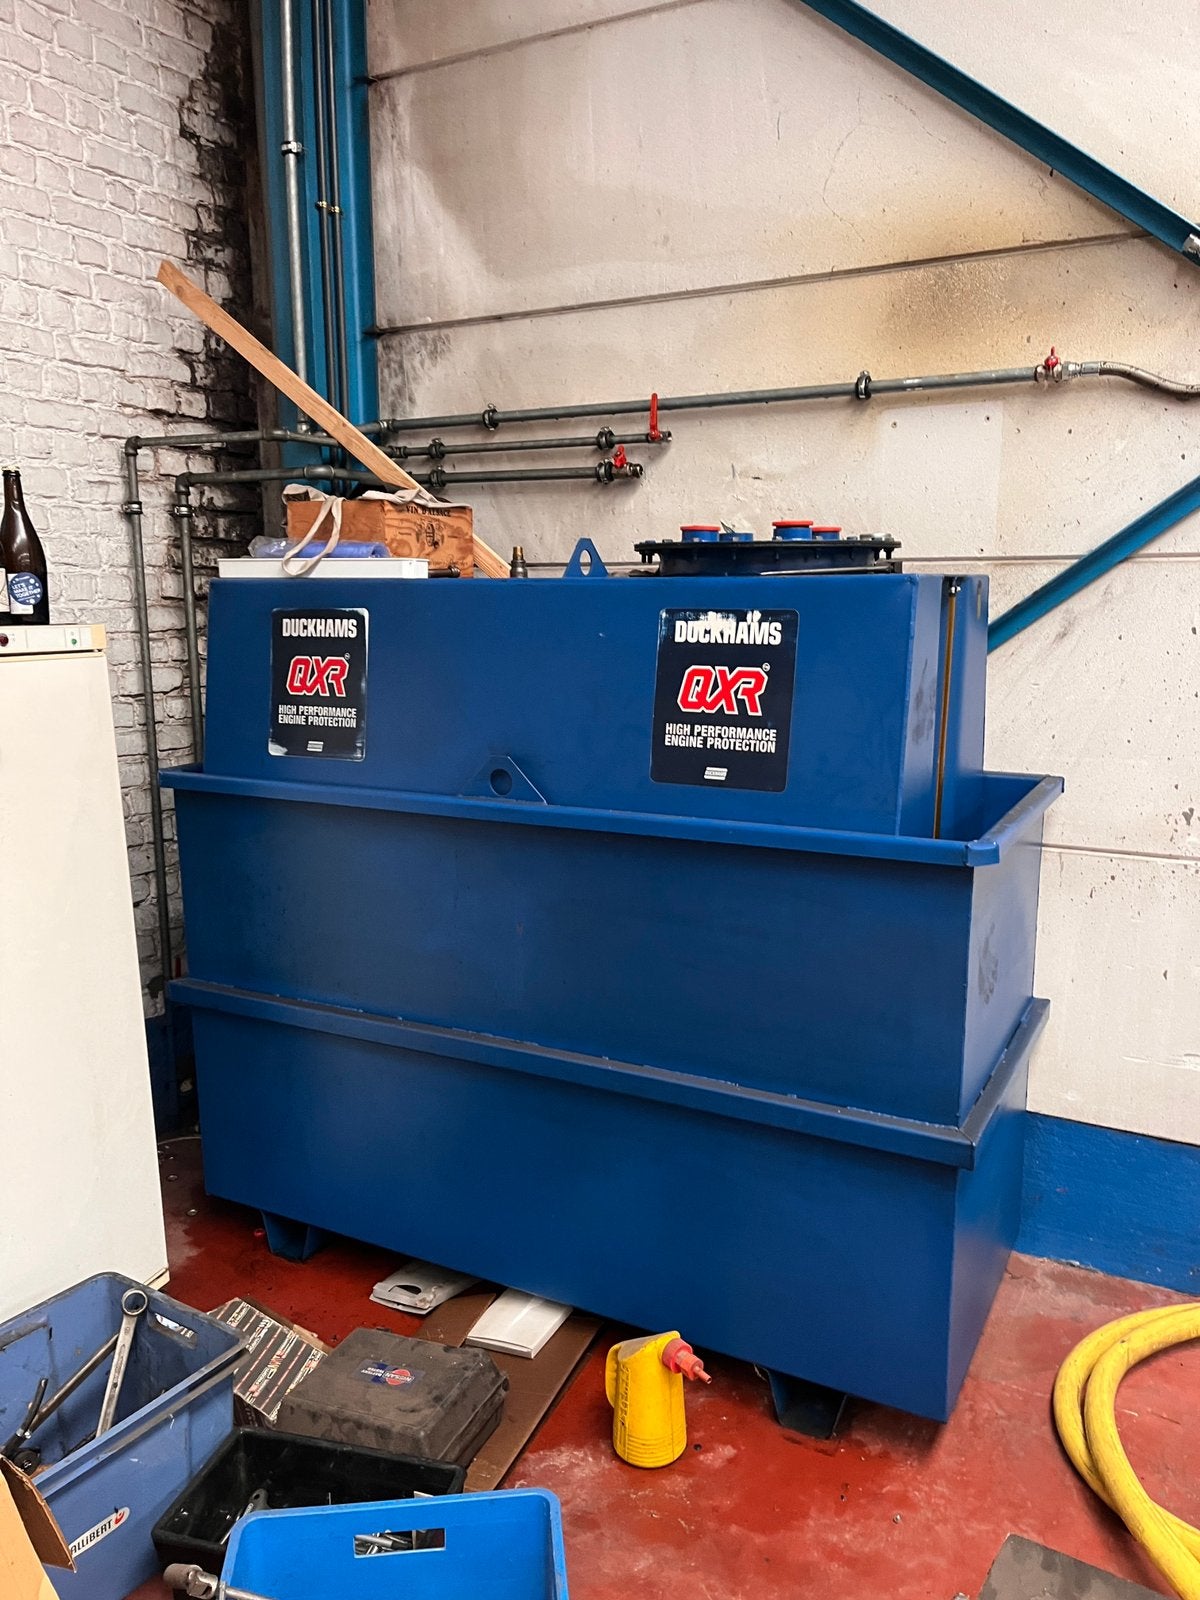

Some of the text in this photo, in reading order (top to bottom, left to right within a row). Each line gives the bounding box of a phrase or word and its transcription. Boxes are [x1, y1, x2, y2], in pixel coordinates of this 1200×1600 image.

[406, 505, 419, 514] VIN
[282, 618, 357, 638] DUCKHAMS
[674, 620, 782, 645] DUCKHAMS
[286, 655, 350, 697] QXR
[677, 664, 769, 716] QXR
[278, 704, 357, 718] HIGH PERFORMANCE
[278, 714, 357, 728] ENGINE PROTECTION
[665, 722, 777, 742] HIGH PERFORMANCE
[664, 734, 776, 753] ENGINE PROTECTION
[384, 1372, 413, 1382] NISSAN
